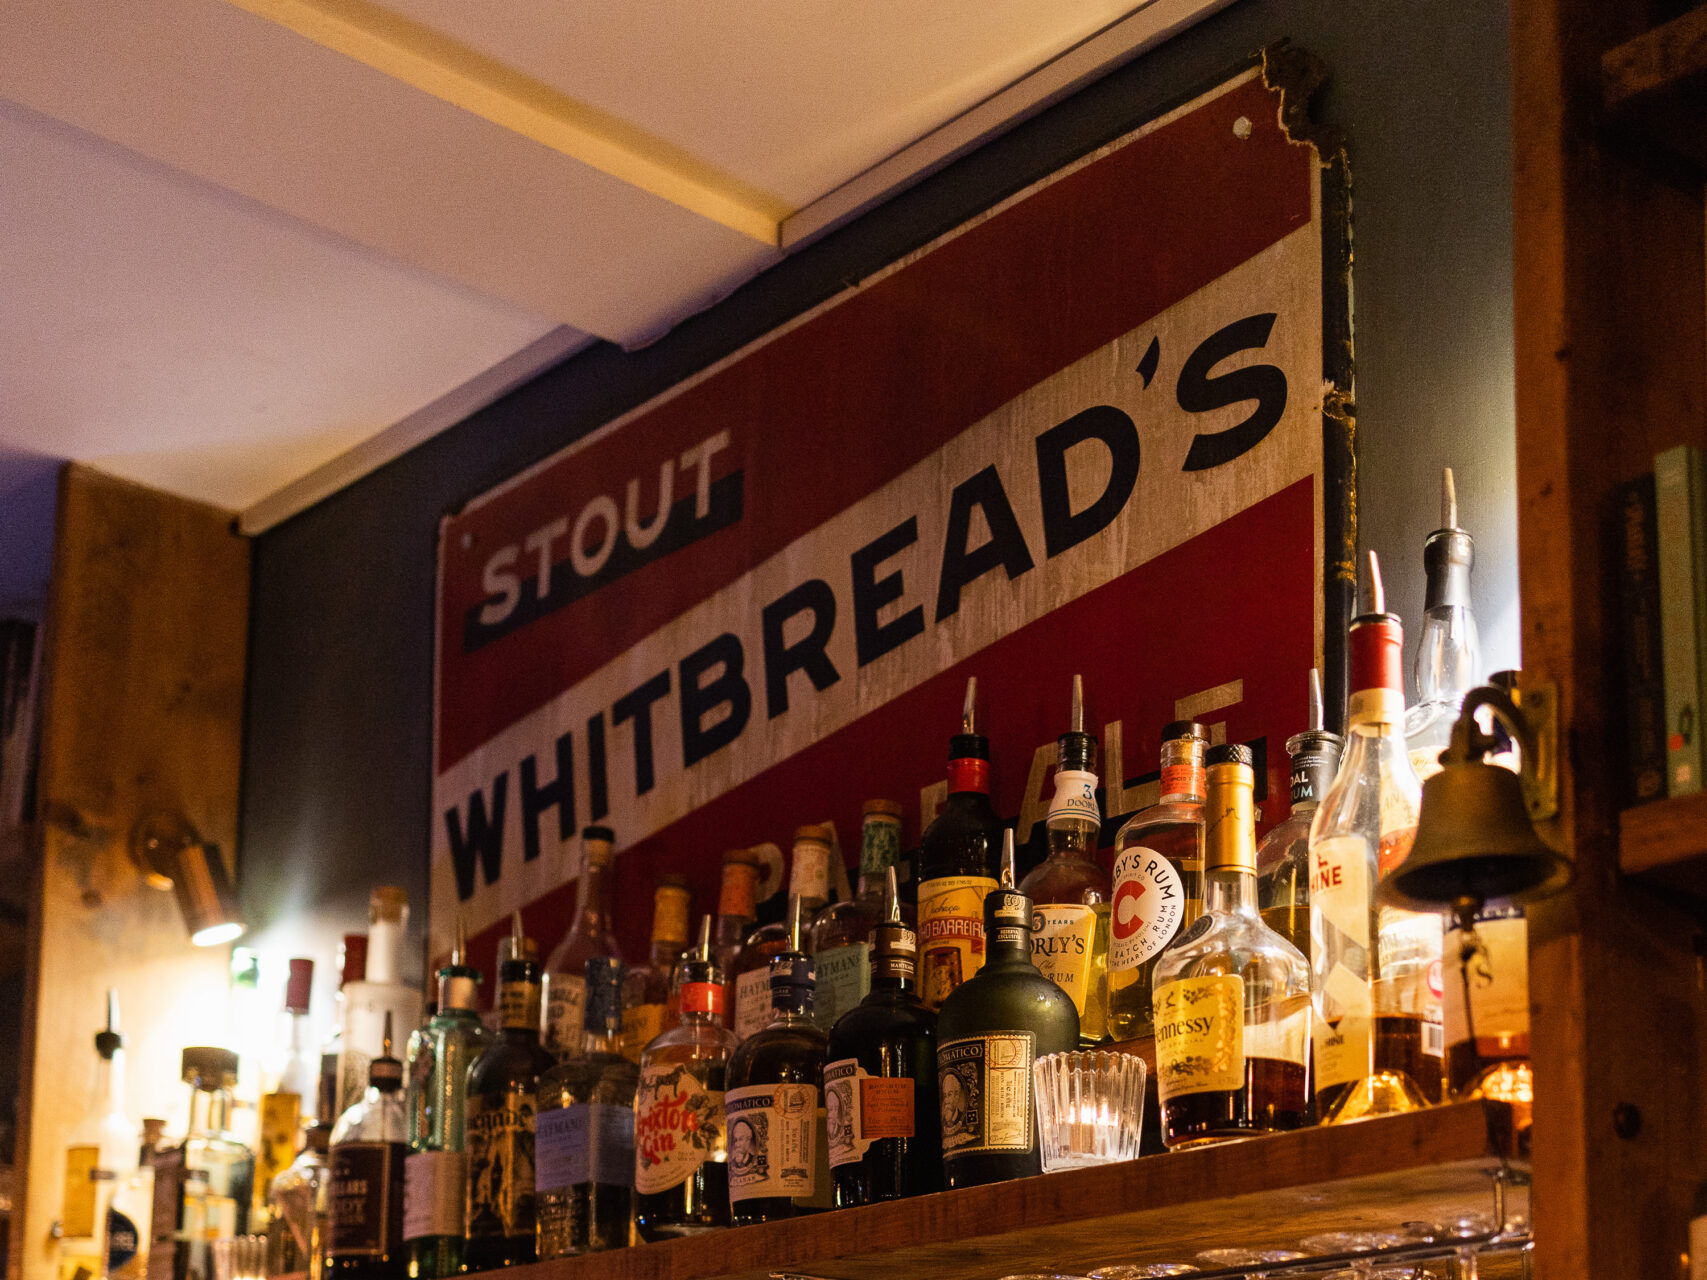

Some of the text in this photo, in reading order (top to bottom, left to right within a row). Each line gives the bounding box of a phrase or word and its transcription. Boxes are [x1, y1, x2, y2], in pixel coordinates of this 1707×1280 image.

[478, 428, 732, 628] STOUT
[443, 312, 1289, 904] WHITBREAD'S
[1082, 783, 1093, 799] 3
[1145, 859, 1176, 901] RUM
[1113, 880, 1147, 940] C
[1115, 905, 1168, 959] BATCH RUM
[1121, 951, 1144, 966] HEART
[1147, 941, 1157, 951] OF
[1158, 904, 1177, 939] LONDON
[1154, 1015, 1215, 1044] ennessy
[643, 1131, 677, 1167] Gin
